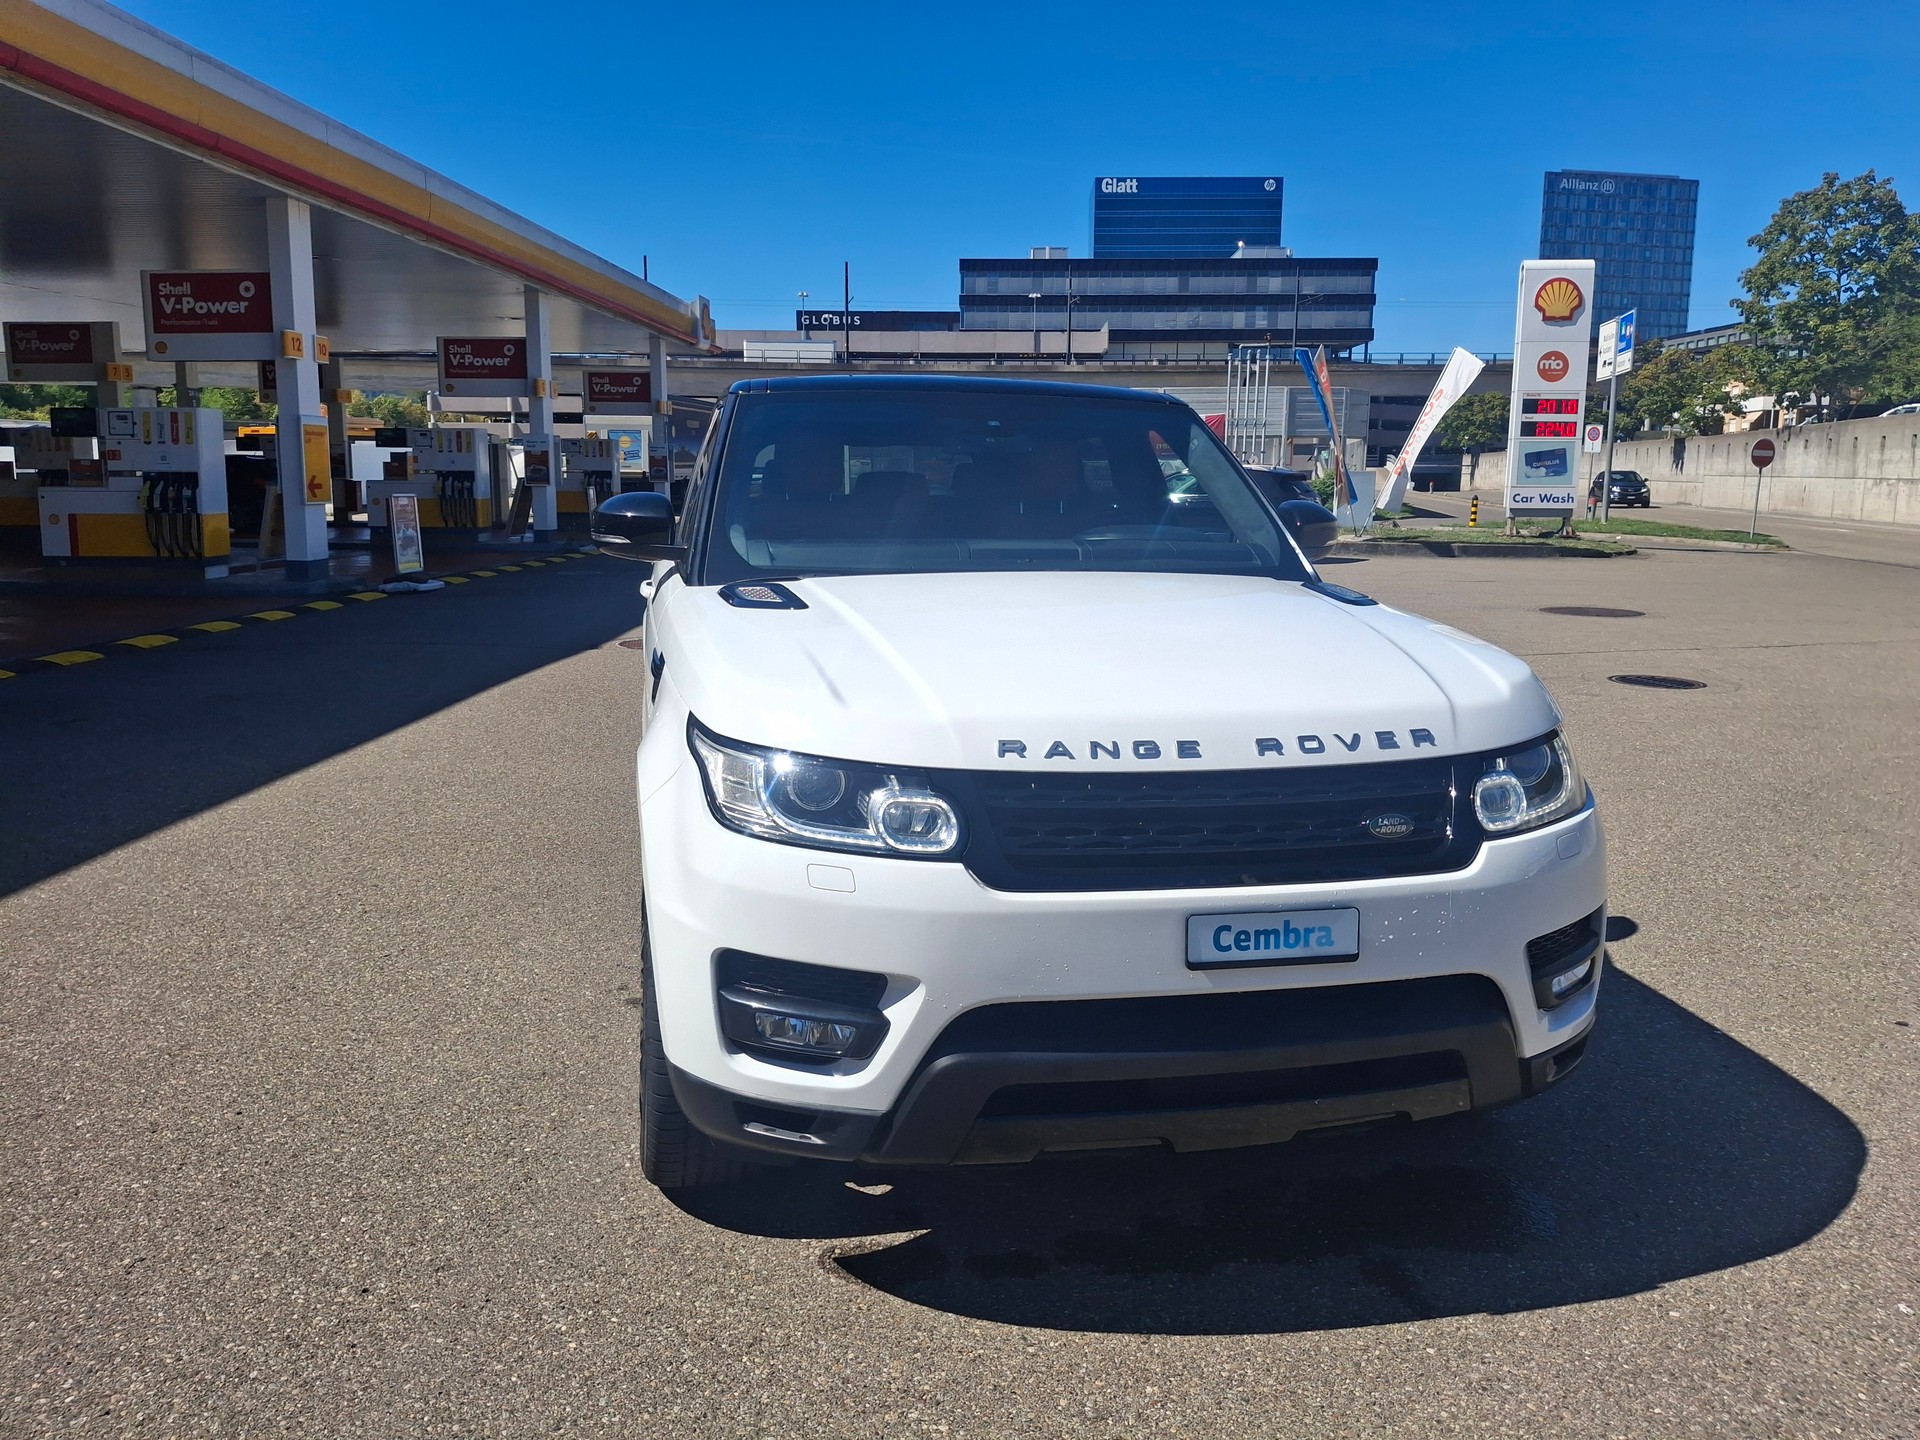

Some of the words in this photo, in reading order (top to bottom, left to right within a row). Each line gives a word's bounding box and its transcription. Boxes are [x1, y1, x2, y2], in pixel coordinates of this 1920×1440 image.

[1101, 178, 1138, 193] Glatt
[1560, 178, 1599, 190] Allianz
[158, 282, 191, 295] Shell
[161, 297, 249, 314] V-Power
[801, 315, 861, 325] GLOBUS
[14, 329, 37, 339] Shell
[16, 340, 76, 351] V-Power
[291, 338, 302, 352] 12
[319, 343, 327, 355] 10
[449, 344, 471, 353] Shell
[450, 354, 510, 367] V-Power
[1540, 356, 1564, 370] mio
[592, 376, 609, 384] Shell
[592, 384, 639, 393] V-Power
[1533, 459, 1560, 468] CUMULUS
[1512, 493, 1535, 503] Car
[1539, 492, 1574, 503] Wash
[997, 739, 1203, 760] RANGE
[1255, 728, 1438, 757] ROVER
[1212, 919, 1335, 953] Cembra
